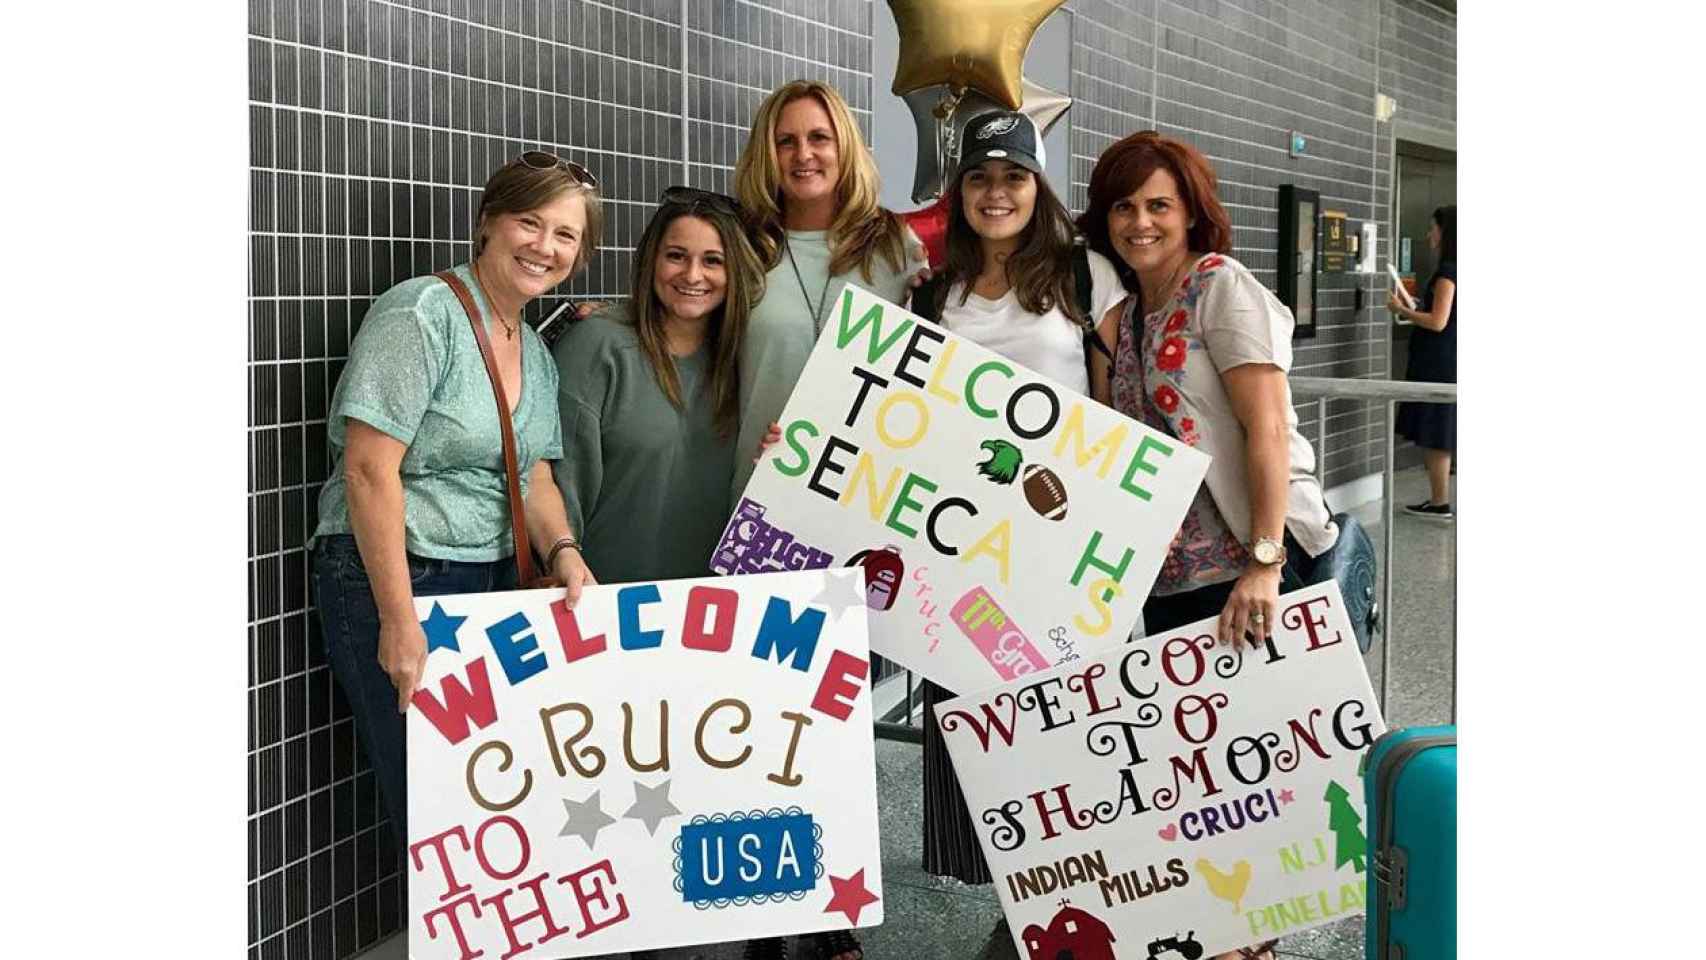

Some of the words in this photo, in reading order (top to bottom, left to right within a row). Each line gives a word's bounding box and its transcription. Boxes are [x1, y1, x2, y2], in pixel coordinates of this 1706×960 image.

[834, 291, 1174, 501] WELCOME
[845, 366, 930, 449] TO
[772, 420, 1014, 585] SENECA
[413, 583, 869, 746] WELCOME
[465, 698, 813, 812] CRUCI
[1086, 692, 1229, 766] TO
[982, 699, 1374, 851] SHAMONG
[1179, 788, 1280, 842] CRUCI
[409, 814, 531, 902] TO
[701, 829, 801, 886] USA
[1006, 849, 1110, 903] INDIAN
[1098, 858, 1190, 908] MILLS
[1279, 837, 1328, 874] NJ
[423, 858, 630, 960] THE
